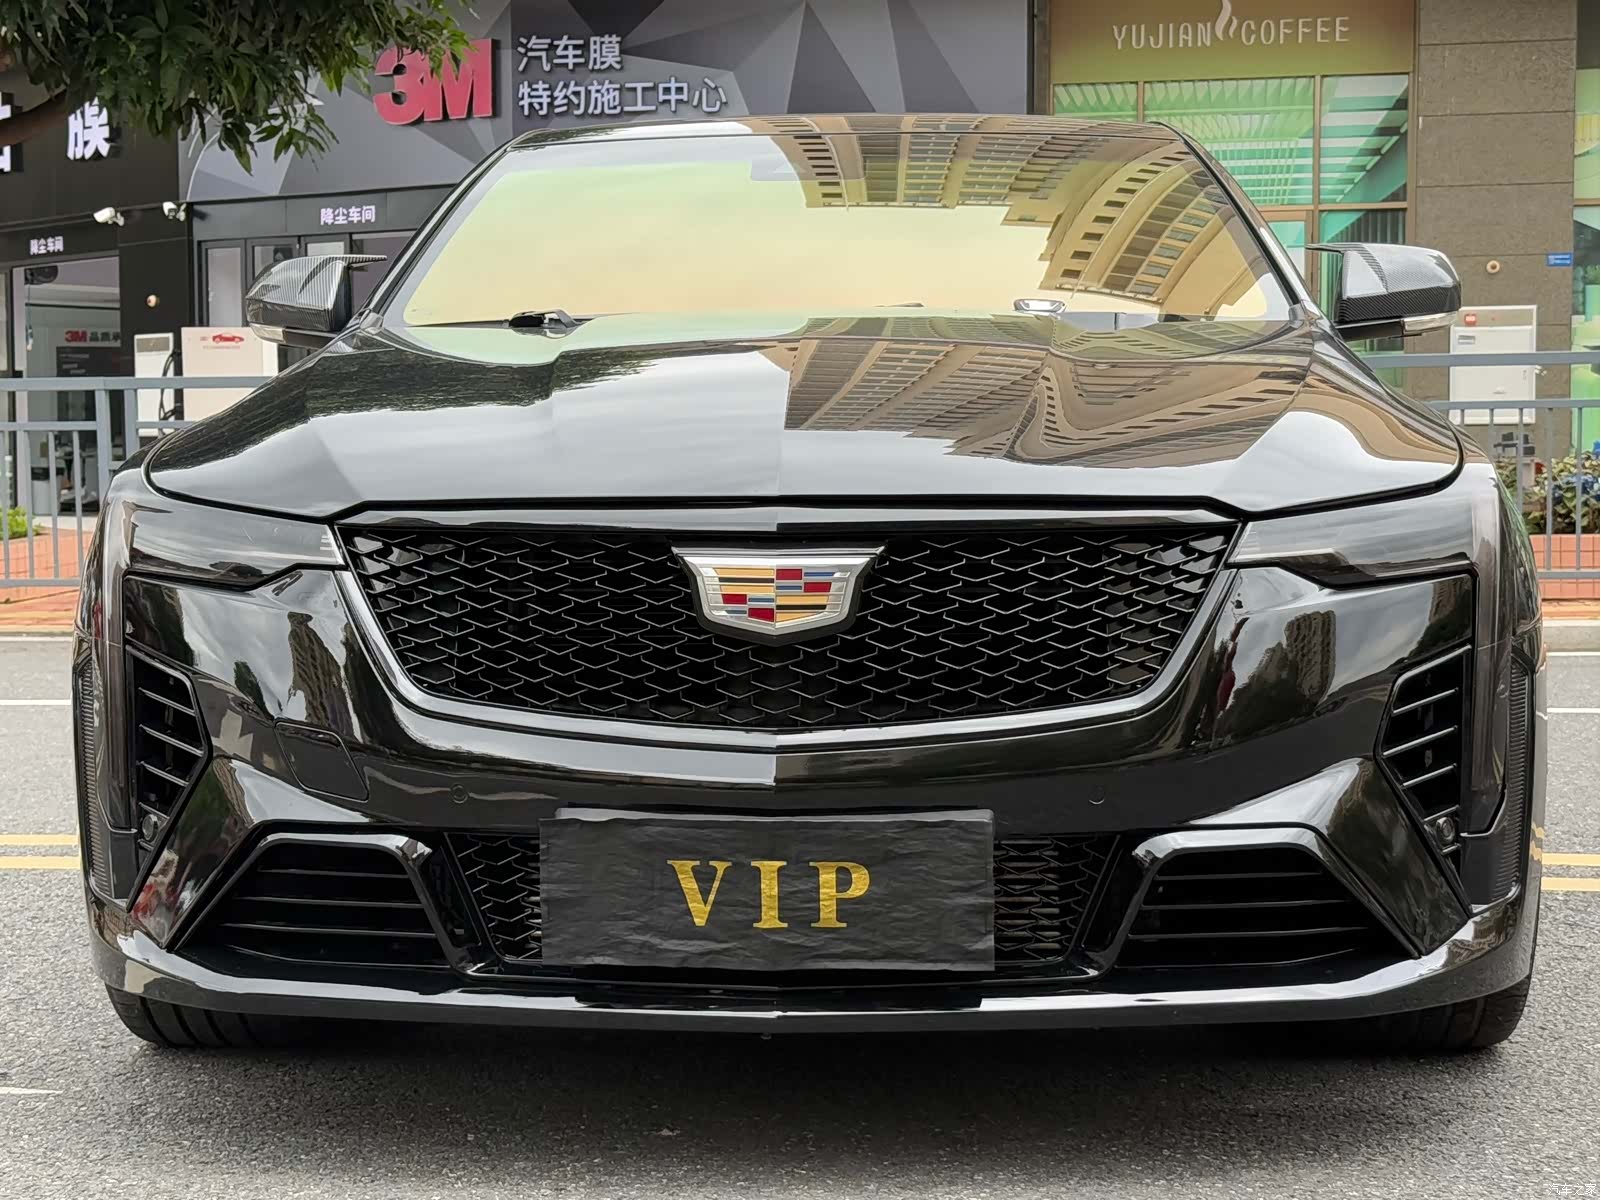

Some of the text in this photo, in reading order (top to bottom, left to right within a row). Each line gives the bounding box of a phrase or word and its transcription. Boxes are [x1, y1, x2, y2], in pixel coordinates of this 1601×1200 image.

[1113, 16, 1350, 50] YUJIAN COFFEE
[516, 34, 622, 73] 汽车膜
[372, 38, 492, 125] 3M
[517, 76, 728, 117] 特约施工中心
[320, 205, 376, 226] 降尘车间
[65, 330, 87, 343] 3M
[667, 859, 872, 929] VIP
